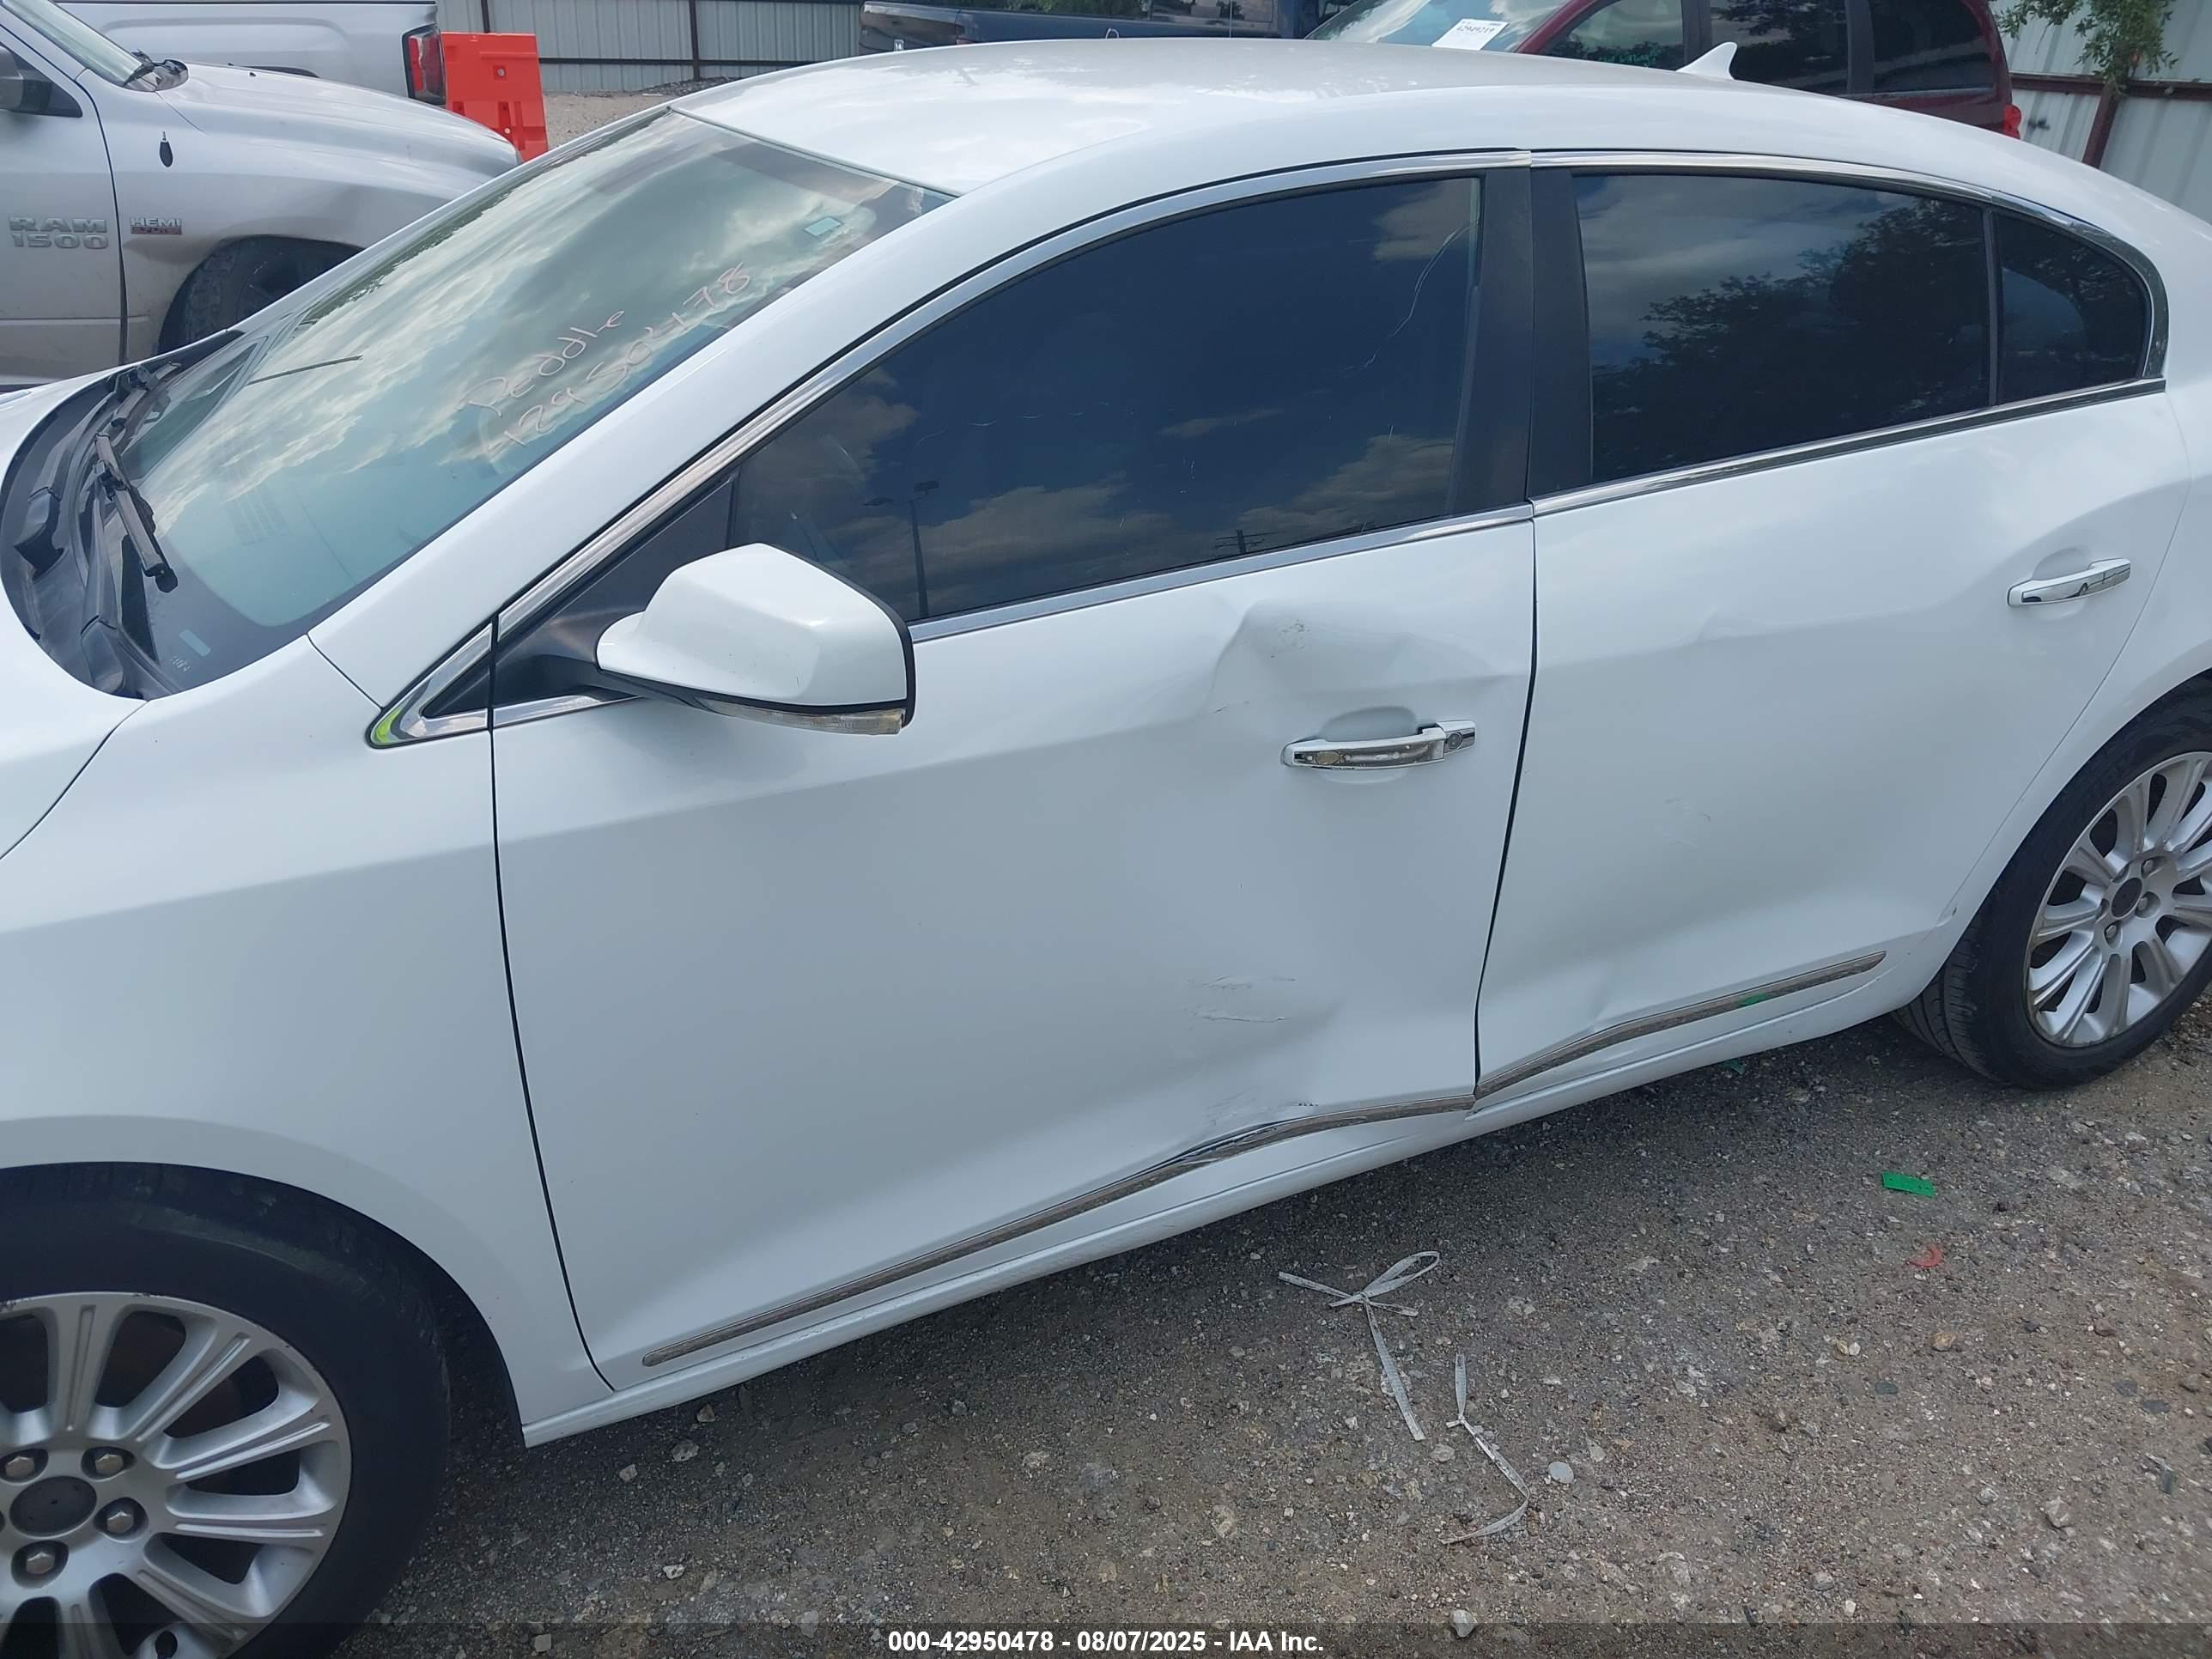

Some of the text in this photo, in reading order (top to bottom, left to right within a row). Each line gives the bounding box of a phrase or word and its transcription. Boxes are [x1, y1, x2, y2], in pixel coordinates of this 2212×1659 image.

[9, 217, 107, 234] RAM
[130, 217, 181, 227] HEMI
[12, 233, 109, 249] 1500
